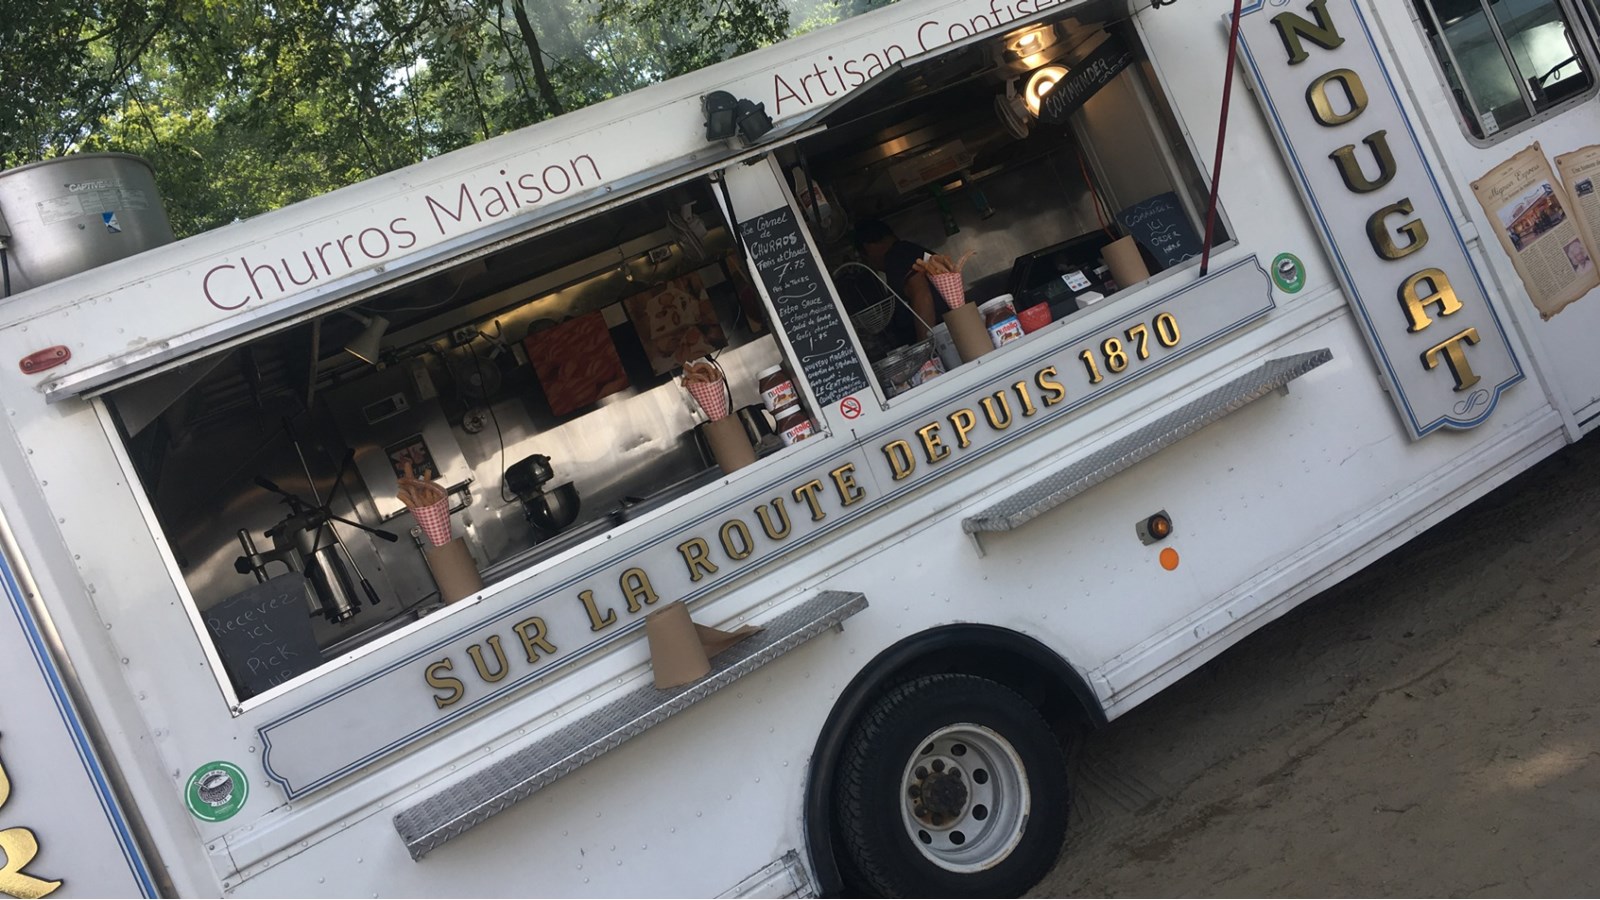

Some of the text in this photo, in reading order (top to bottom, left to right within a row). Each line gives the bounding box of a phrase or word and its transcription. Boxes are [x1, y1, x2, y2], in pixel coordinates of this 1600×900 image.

[773, 44, 907, 115] Artisan
[1045, 57, 1109, 119] COMMANDER
[1269, 0, 1482, 392] NOUGAT
[202, 153, 602, 311] Churros Maison
[750, 231, 798, 260] CHURROS
[760, 229, 772, 239] de
[773, 258, 806, 284] 7.75
[996, 322, 1018, 336] nutella
[767, 381, 793, 398] nutella
[786, 420, 811, 439] nutella
[424, 311, 1182, 710] SUR LA ROUTE DEPUIS 1870
